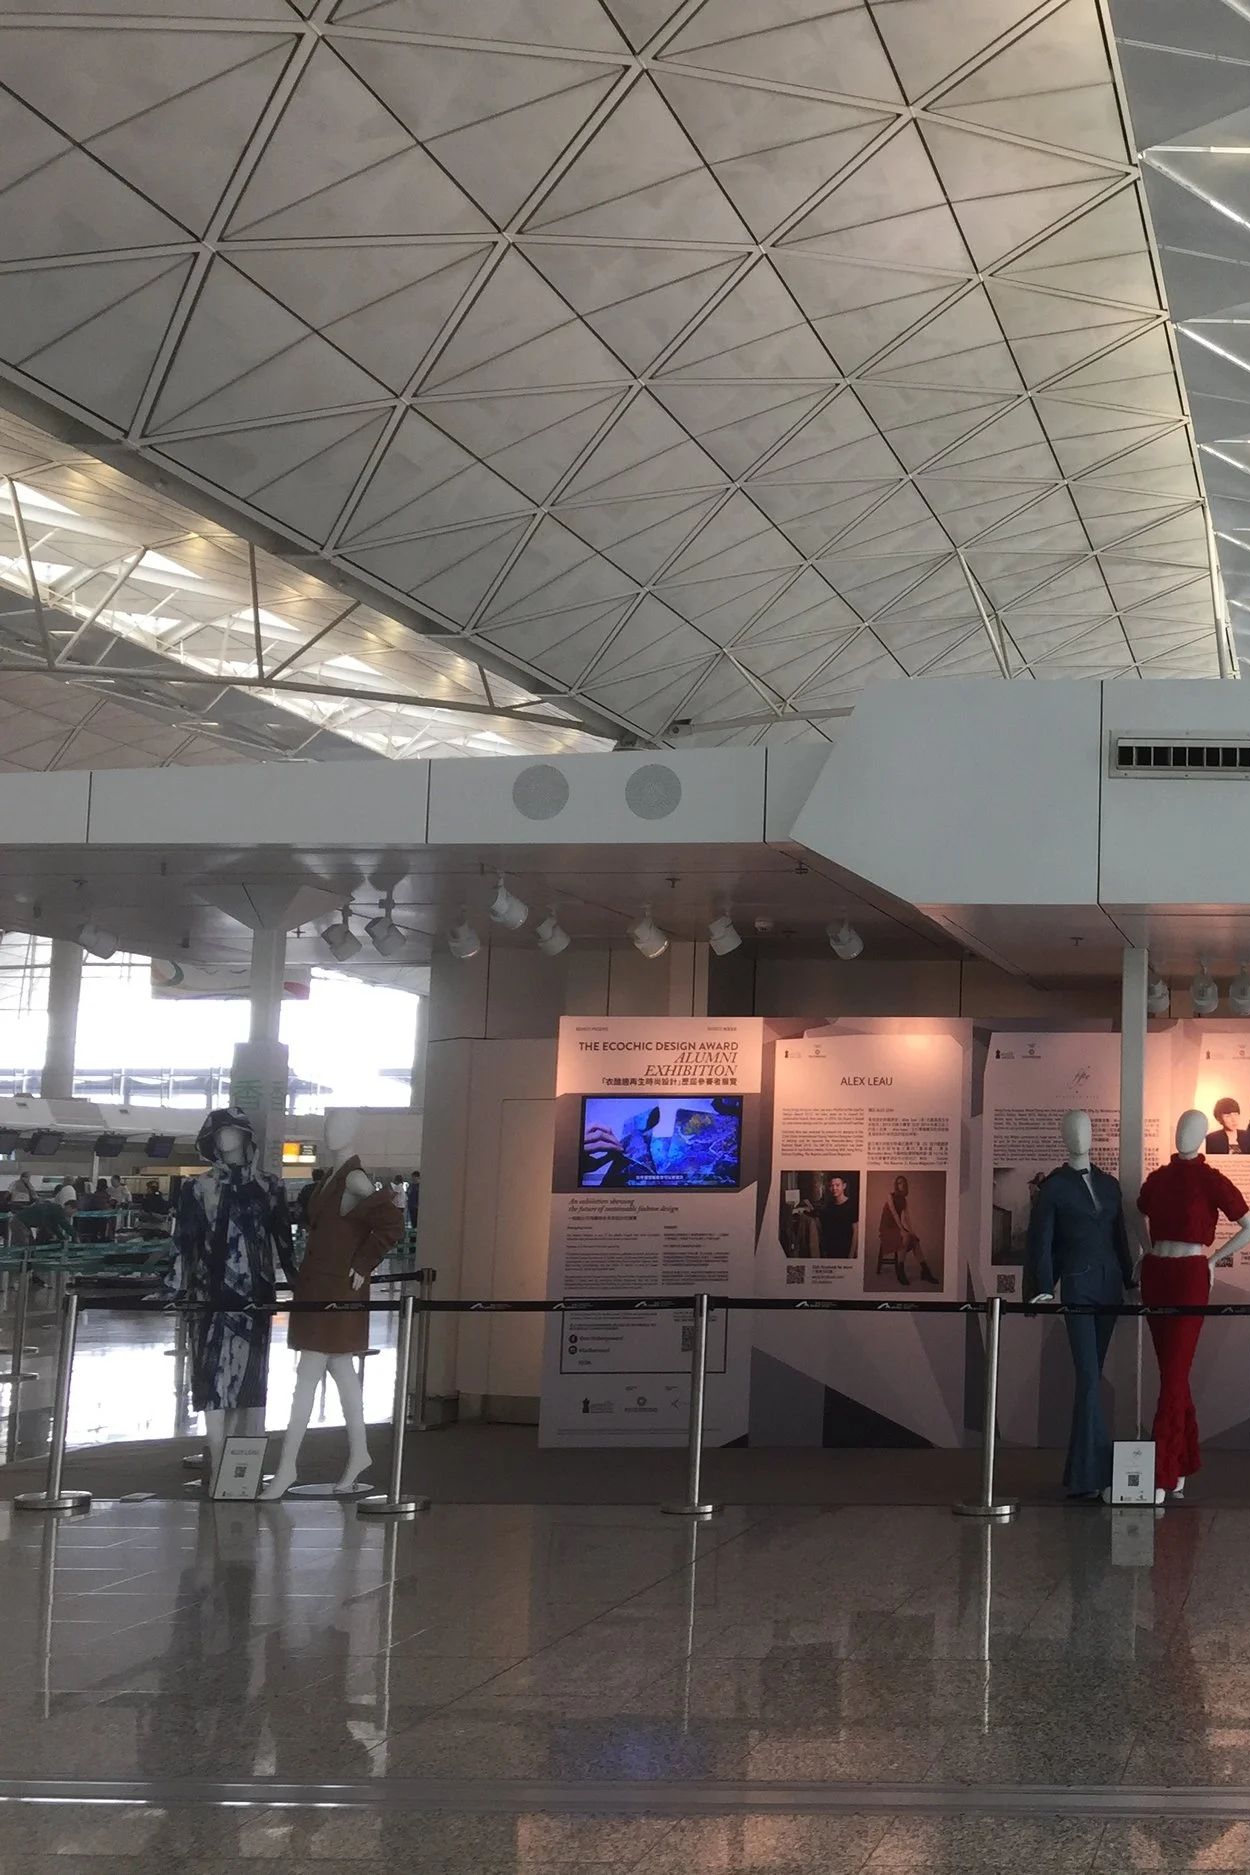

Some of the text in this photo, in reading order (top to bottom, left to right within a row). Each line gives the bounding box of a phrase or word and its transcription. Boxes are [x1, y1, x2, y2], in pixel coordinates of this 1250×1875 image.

[579, 1041, 739, 1051] THE ECOCHIC DESIGN AWARD
[674, 1051, 738, 1064] ALUMNI
[644, 1064, 738, 1077] EXHIBITION
[840, 1076, 893, 1087] ALEX LEAU
